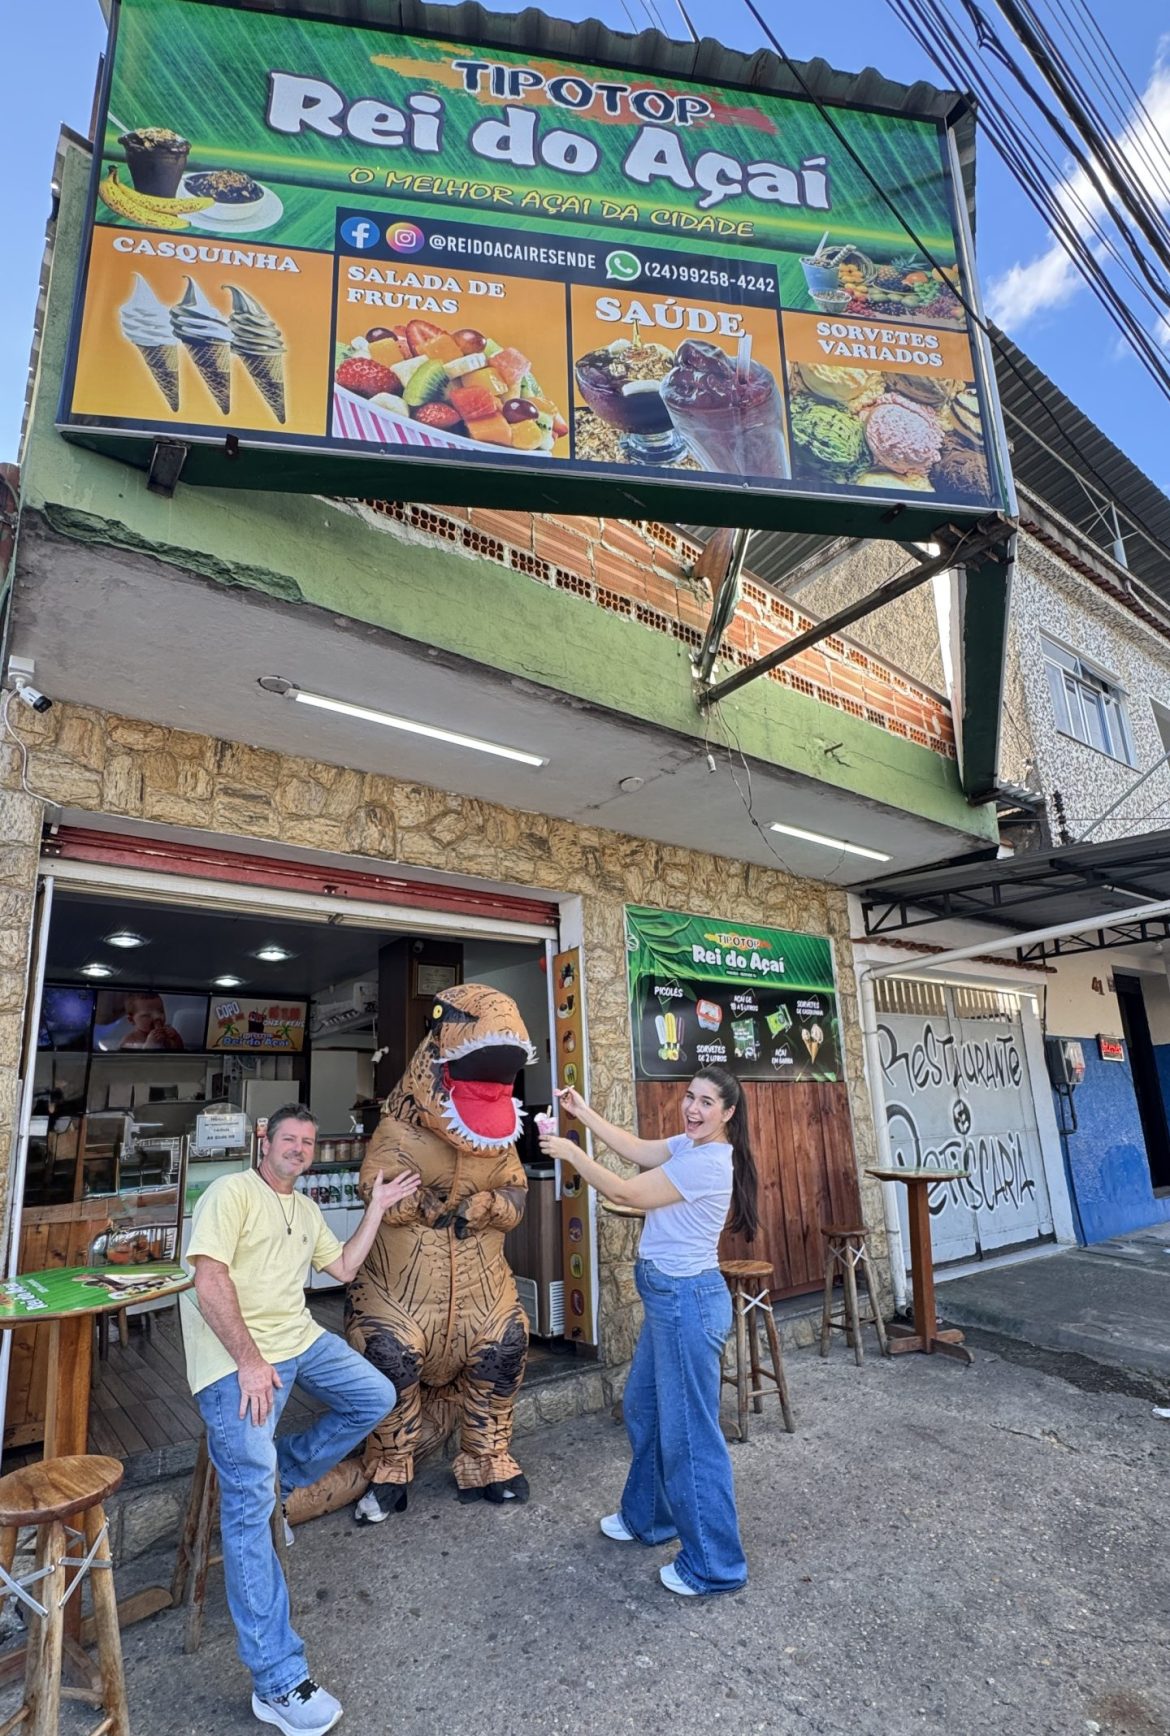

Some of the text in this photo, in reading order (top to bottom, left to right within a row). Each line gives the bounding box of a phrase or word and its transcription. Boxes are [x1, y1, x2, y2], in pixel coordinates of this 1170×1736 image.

[268, 71, 829, 208] Rei do Açaí
[350, 168, 754, 237] O MELHOR AÇAI DA CIDADE
[113, 237, 301, 272] CASQUINHA
[429, 234, 596, 269] @REIDOACAIRESENDE
[348, 266, 506, 298] SALADA DE
[644, 262, 775, 292] (24)99258-4242
[347, 287, 458, 314] FRUTAS
[595, 297, 745, 338] SAÚDE
[817, 322, 940, 348] SORVETES
[818, 339, 944, 367] VARIADOS
[692, 944, 784, 975] Rei do Açaí
[215, 1001, 240, 1019] COPO
[696, 1045, 726, 1054] SORVETES
